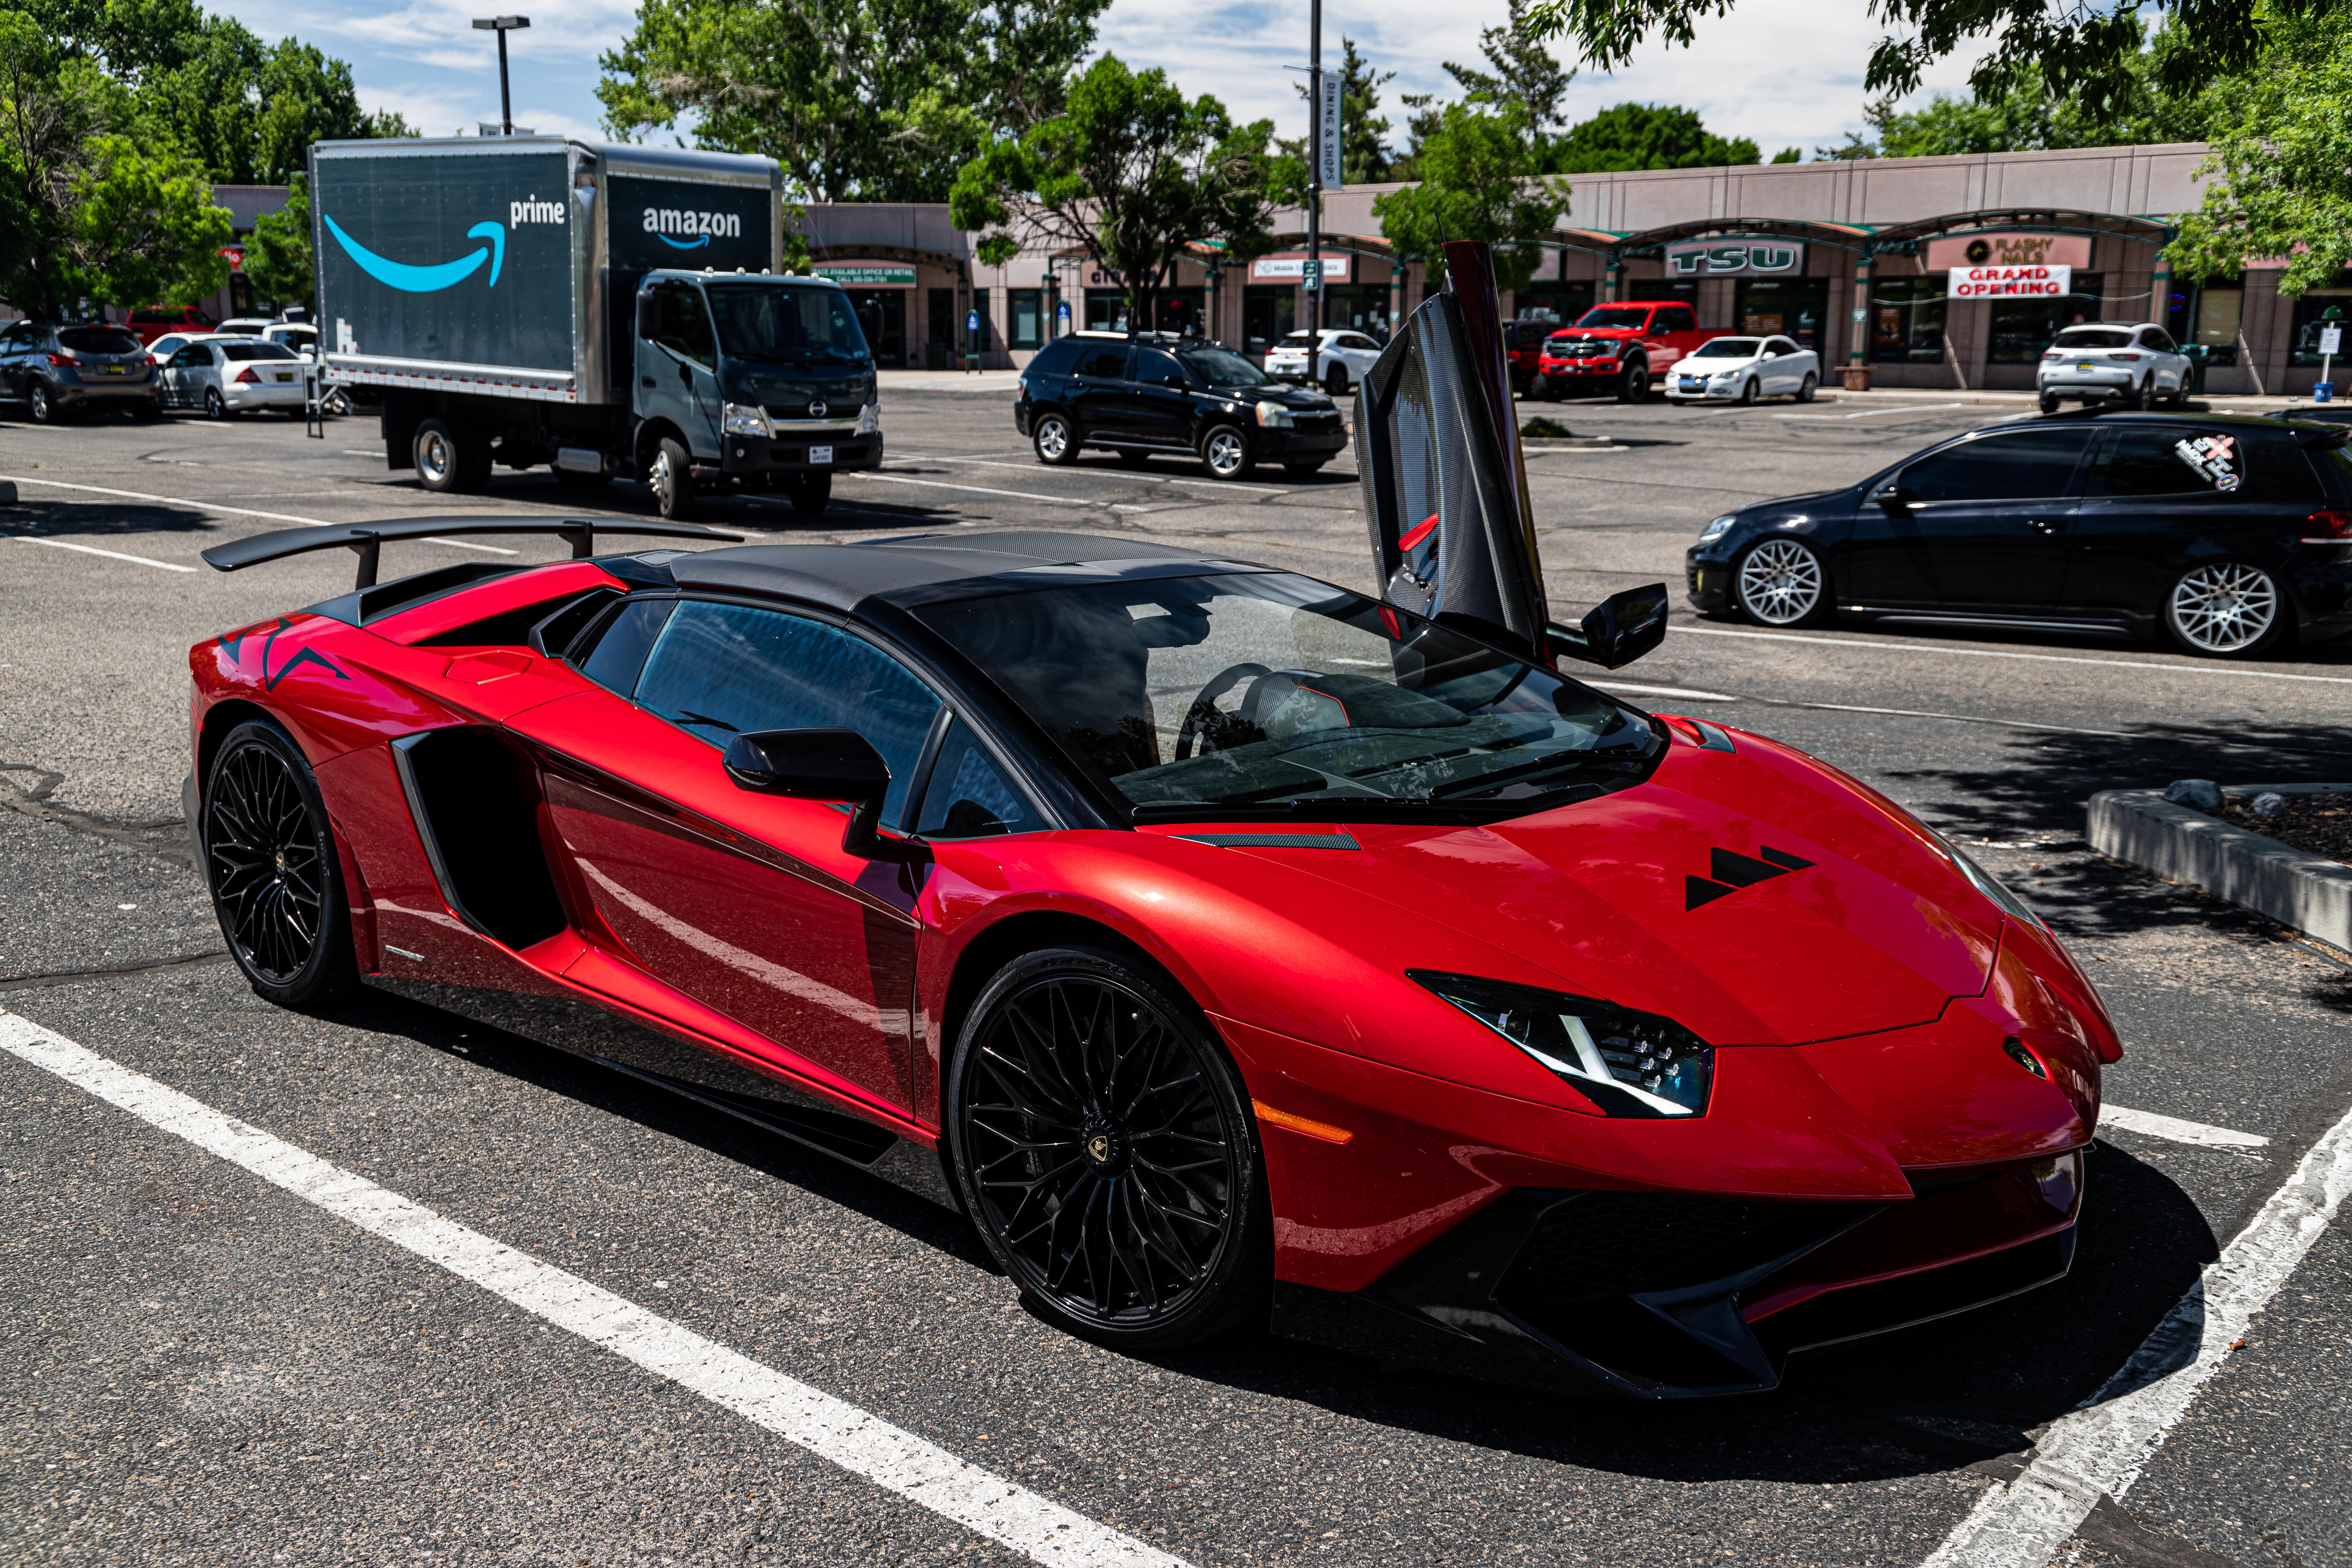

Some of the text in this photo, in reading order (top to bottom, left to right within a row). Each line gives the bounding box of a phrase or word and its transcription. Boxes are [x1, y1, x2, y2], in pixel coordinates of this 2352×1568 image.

[1324, 82, 1336, 182] DINING & SHOPS
[511, 193, 565, 230] prime
[643, 208, 740, 237] amazon
[1995, 237, 2054, 251] FLASHY
[1669, 246, 1794, 273] TSU
[2002, 251, 2045, 264] NAILS
[1969, 268, 2049, 281] GRAND
[1957, 282, 2061, 296] OPENING
